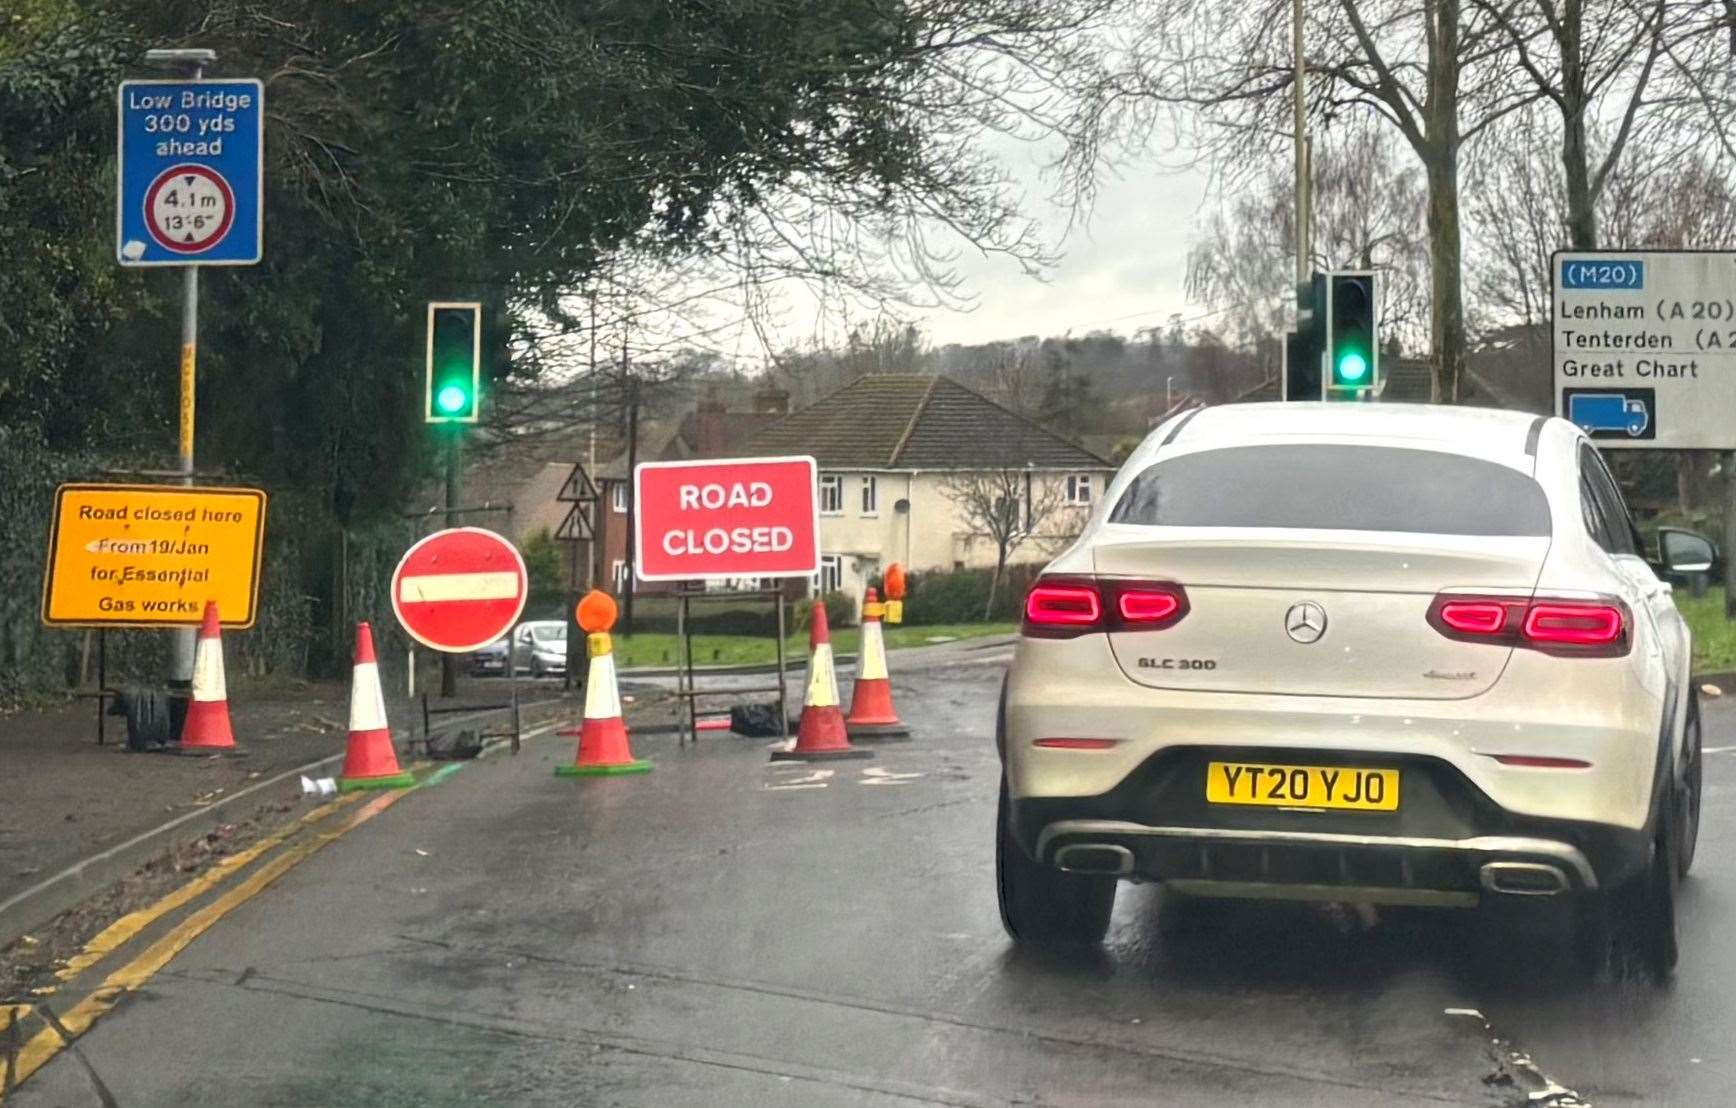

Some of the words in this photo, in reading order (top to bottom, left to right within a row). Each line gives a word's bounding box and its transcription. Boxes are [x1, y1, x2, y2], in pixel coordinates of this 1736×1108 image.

[130, 92, 172, 110] Low
[181, 92, 251, 112] Bridge
[144, 114, 191, 132] 300
[199, 114, 235, 136] yds
[156, 138, 222, 156] ahead
[1568, 264, 1636, 285] (M20)
[1561, 301, 1644, 320] Lenham
[1563, 330, 1673, 349] Tenterden
[1563, 360, 1625, 378] Great
[1636, 360, 1699, 379] Chart
[679, 482, 773, 511] ROAD
[79, 505, 128, 520] Road
[133, 507, 196, 522] closed
[202, 509, 242, 523] here
[662, 526, 793, 556] CLOSED
[91, 566, 117, 581] for
[122, 566, 209, 583] Essential
[99, 596, 135, 612] Gas
[142, 597, 198, 612] works
[1138, 658, 1174, 669] GLC
[1223, 766, 1309, 801] YT20
